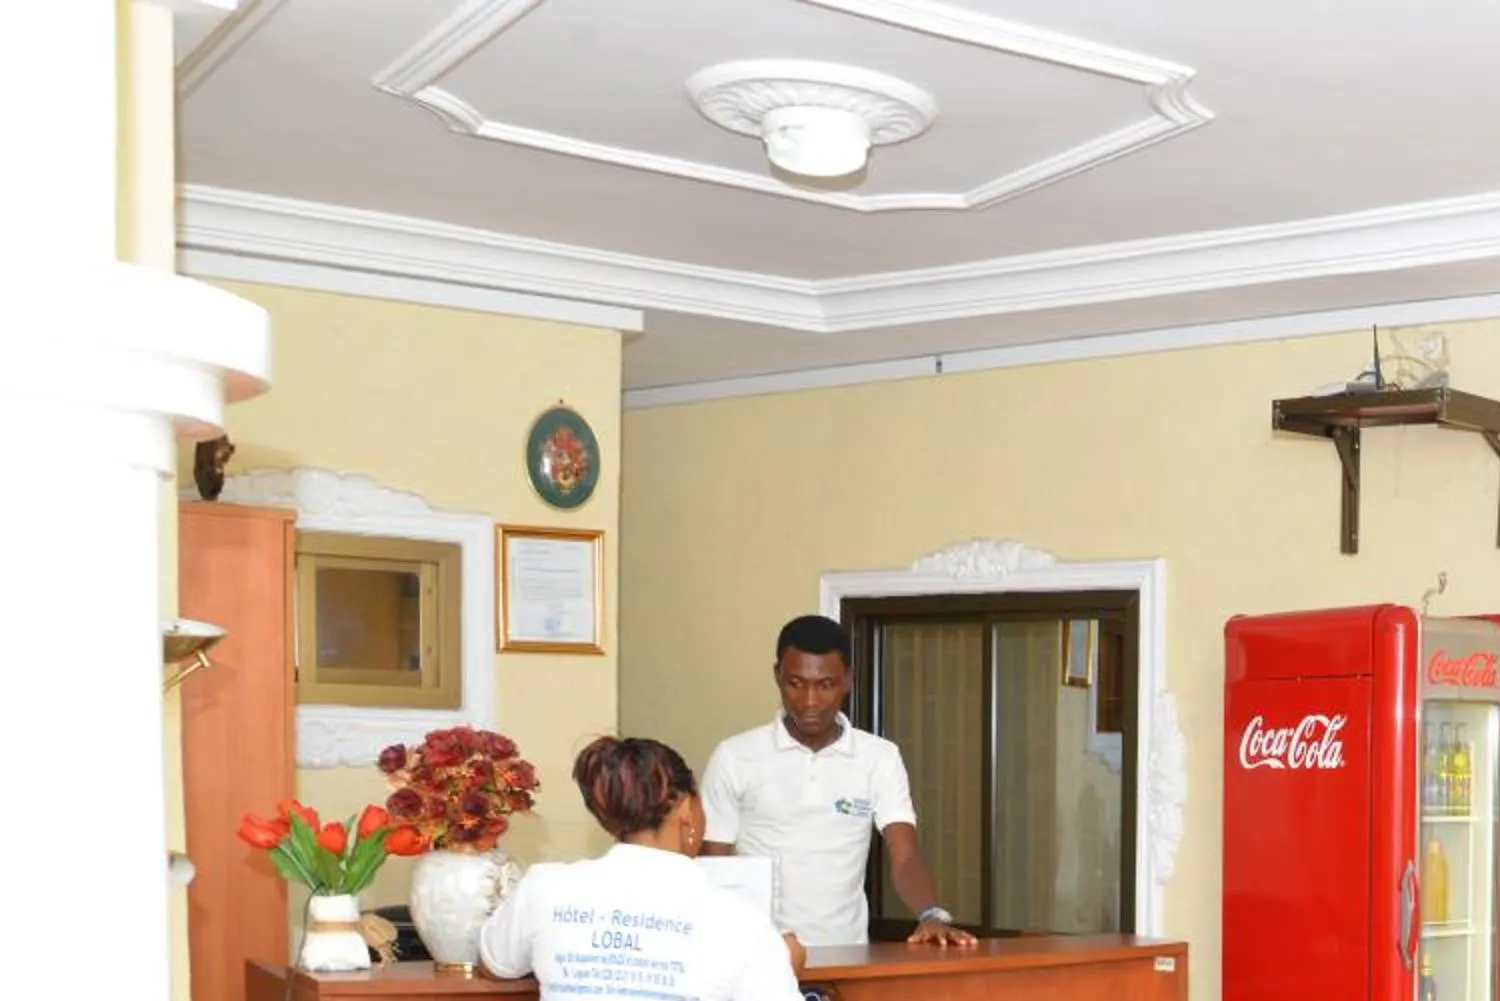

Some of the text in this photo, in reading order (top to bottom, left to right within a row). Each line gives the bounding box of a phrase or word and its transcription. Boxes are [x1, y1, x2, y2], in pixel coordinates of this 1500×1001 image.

[1240, 714, 1348, 769] Coca-Cola
[611, 908, 694, 935] Residence
[591, 929, 643, 952] LOBAL
